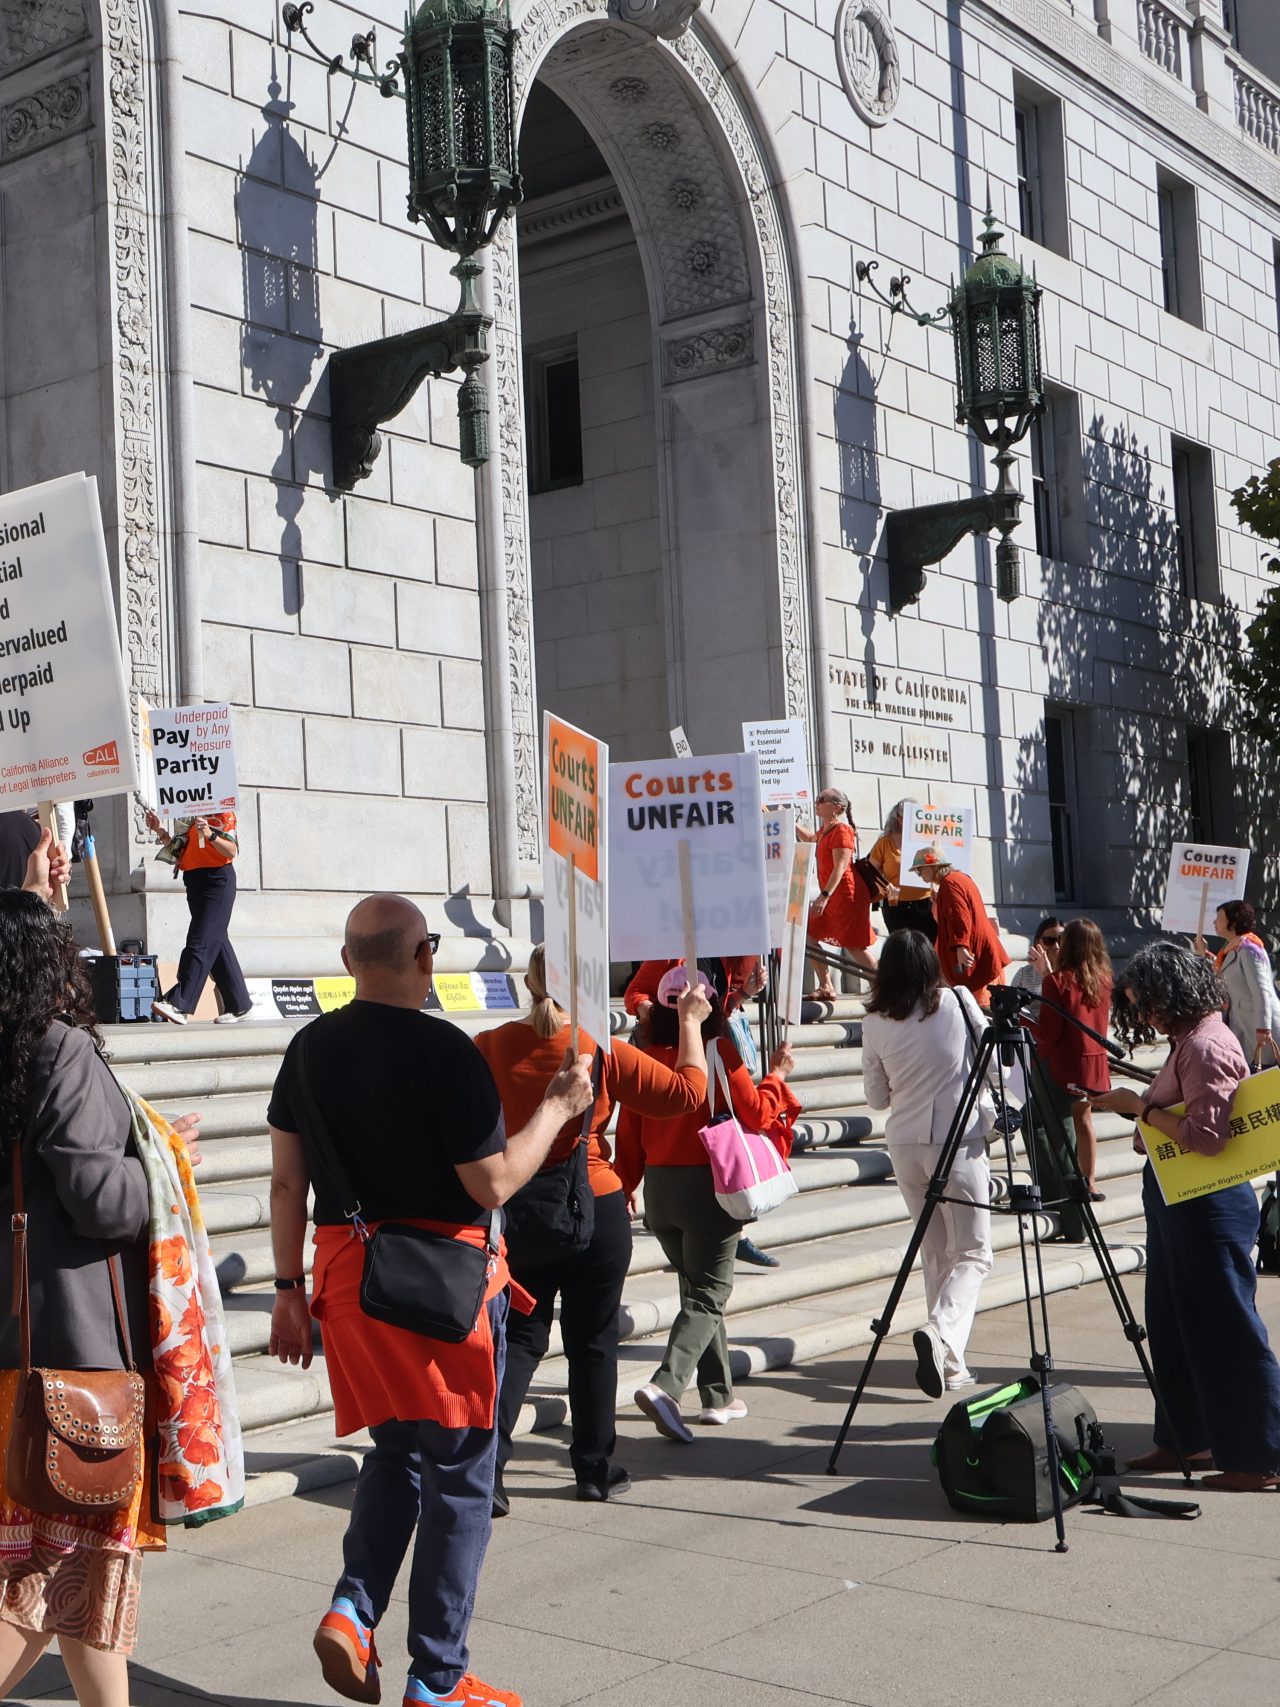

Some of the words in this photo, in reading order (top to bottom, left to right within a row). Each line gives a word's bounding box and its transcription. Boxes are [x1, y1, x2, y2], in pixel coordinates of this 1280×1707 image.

[9, 709, 31, 733] Up
[175, 707, 228, 724] Underpaid
[885, 703, 916, 718] WARREN
[919, 708, 953, 723] BUILDING
[153, 728, 190, 748] Pay
[197, 725, 208, 739] by
[211, 723, 230, 737] Any
[84, 747, 116, 765] CALI
[190, 740, 231, 752] Measure
[854, 739, 874, 754] 350
[1, 762, 36, 778] California
[38, 756, 69, 771] Alliance
[156, 754, 220, 775] Parity
[552, 737, 595, 794] Courts
[760, 757, 794, 765] Undervalued
[760, 767, 789, 775] Underpaid
[0, 783, 7, 794] of
[9, 779, 29, 793] Legal
[31, 770, 76, 788] Interpreters
[625, 769, 733, 799] Courts
[159, 782, 213, 805] Now!
[551, 785, 595, 848] UNFAIR
[627, 801, 735, 830] UNFAIR
[915, 810, 963, 823] Courts
[915, 823, 963, 837] UNFAIR
[1184, 850, 1237, 865] Courts
[1181, 864, 1234, 880] UNFAIR
[1178, 1180, 1217, 1198] Language
[1218, 1173, 1243, 1188] Rights
[1245, 1168, 1258, 1177] Are
[1260, 1161, 1276, 1171] Civil
